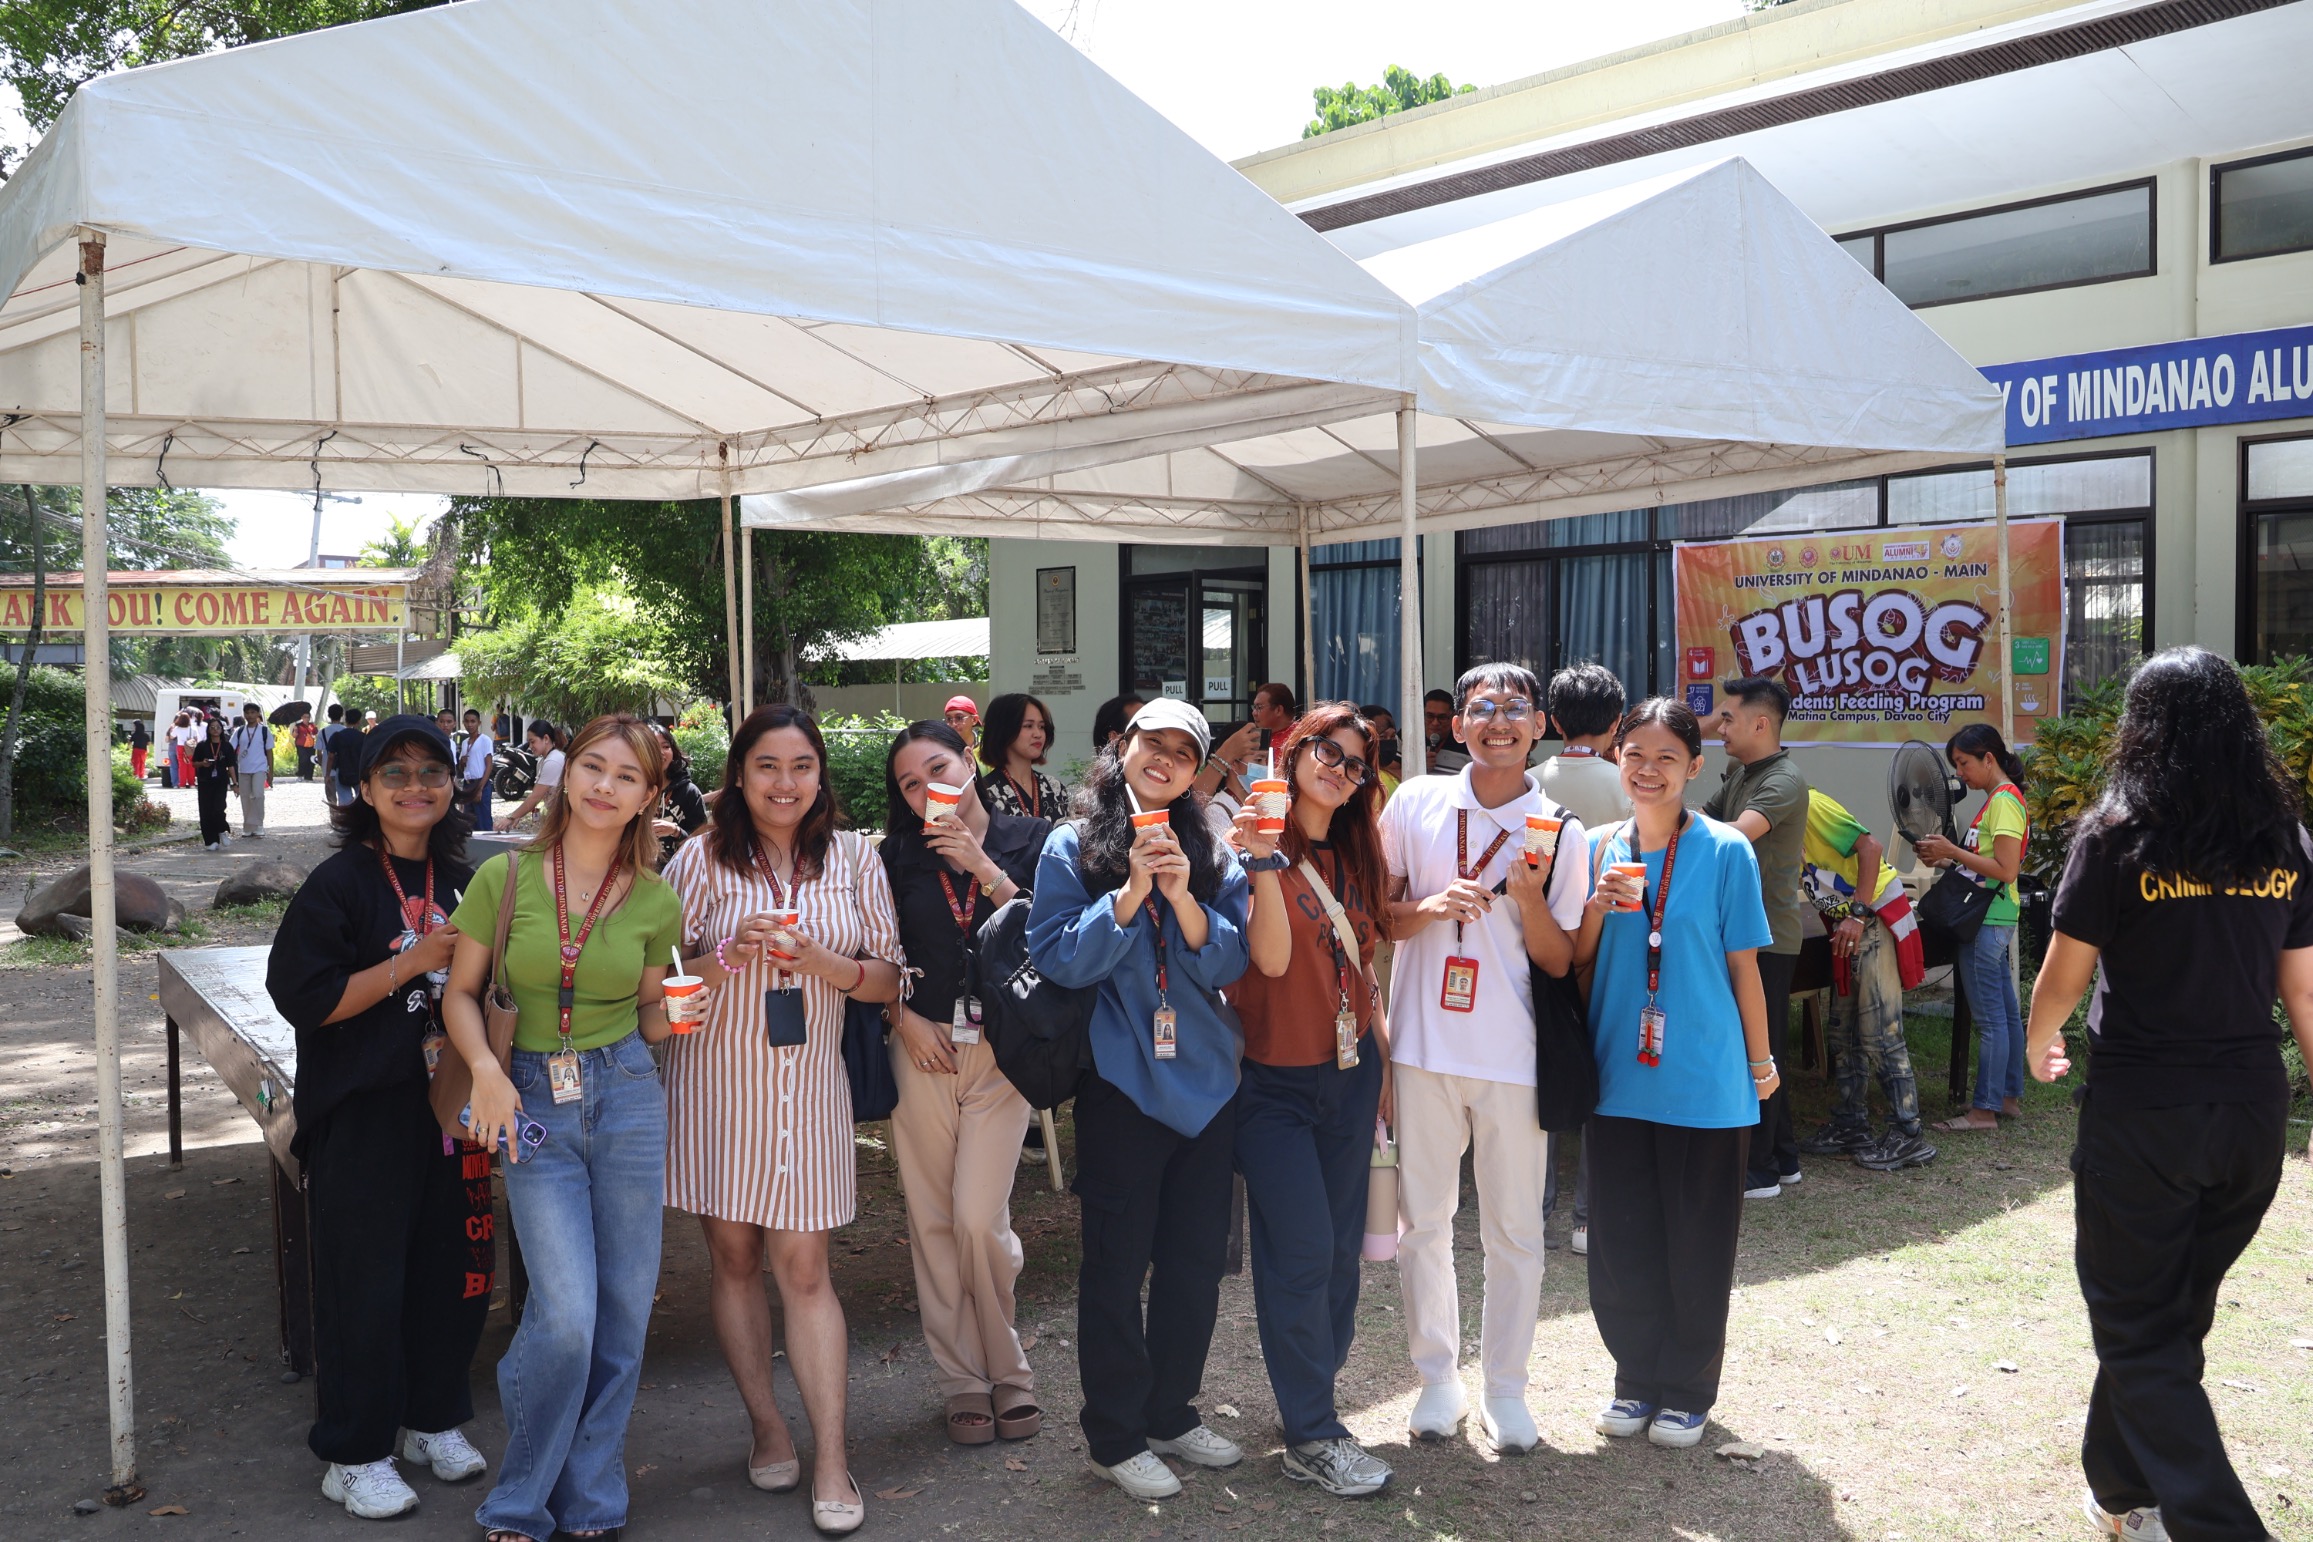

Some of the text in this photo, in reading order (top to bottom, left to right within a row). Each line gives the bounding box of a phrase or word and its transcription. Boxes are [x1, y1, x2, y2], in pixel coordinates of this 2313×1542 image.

[2021, 375, 2058, 428] OF
[2068, 353, 2236, 423] MINDANAO
[2247, 344, 2313, 405] ALU
[1842, 545, 1871, 561] UM
[1885, 547, 1913, 557] ALUMNI
[1735, 572, 1813, 588] UNIVERSITY
[1818, 571, 1837, 584] OF
[1841, 566, 1928, 583] MINDANAO
[1944, 563, 1988, 578] MAIN
[0, 593, 73, 626] ANK
[174, 591, 269, 626] COME
[1739, 593, 1985, 673] BUSOG
[2015, 641, 2020, 649] 3
[1794, 650, 1931, 695] LUSOG
[1165, 685, 1183, 694] PULL
[1208, 681, 1228, 691] PULL
[2015, 682, 2020, 691] 2
[1790, 693, 1984, 713] dents Feeding Program
[1787, 710, 1951, 724] Matina Campus, Davao City
[587, 896, 605, 932] LEADERSHIP
[342, 1472, 358, 1489] N
